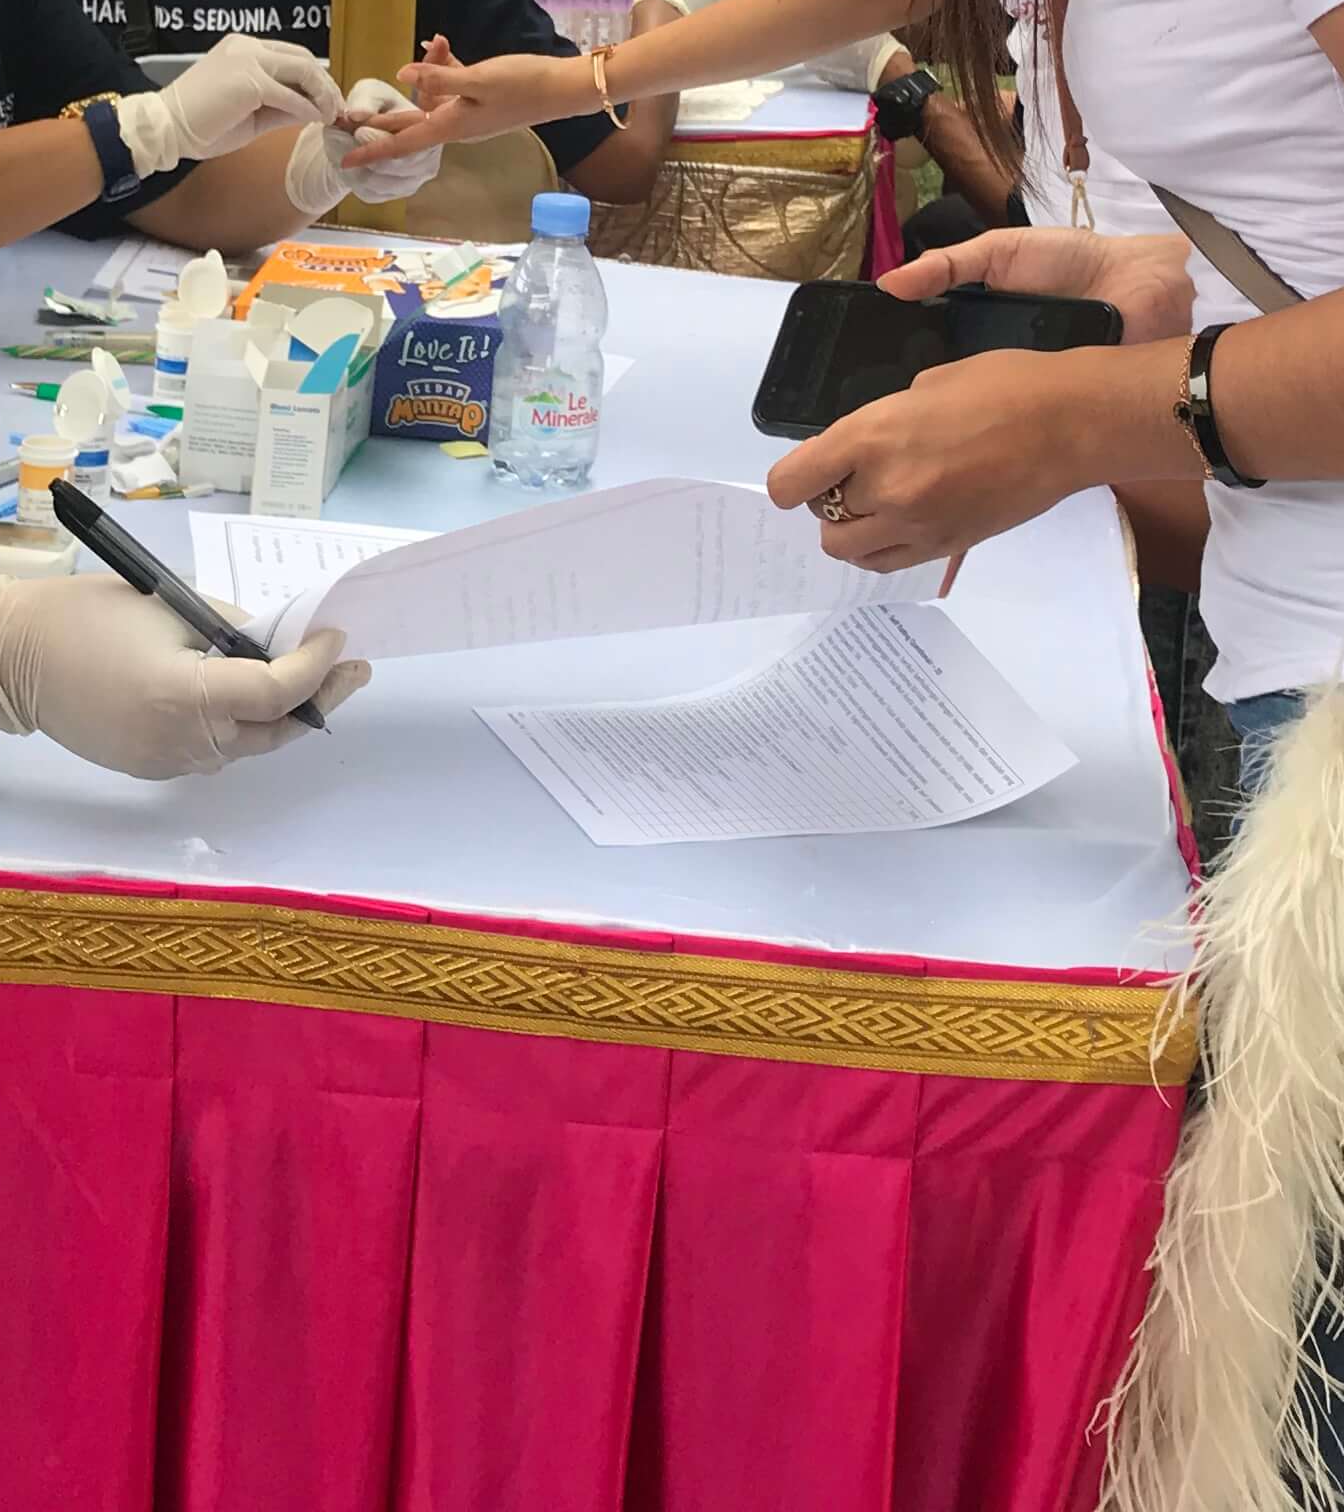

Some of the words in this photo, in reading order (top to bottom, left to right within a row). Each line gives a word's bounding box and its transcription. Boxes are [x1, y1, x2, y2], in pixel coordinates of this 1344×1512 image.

[192, 6, 282, 33] SEDUNIA
[292, 4, 332, 29] 201
[398, 330, 454, 367] Love
[413, 382, 465, 398] SEDAP
[567, 391, 587, 411] Le
[531, 406, 599, 427] Minerale
